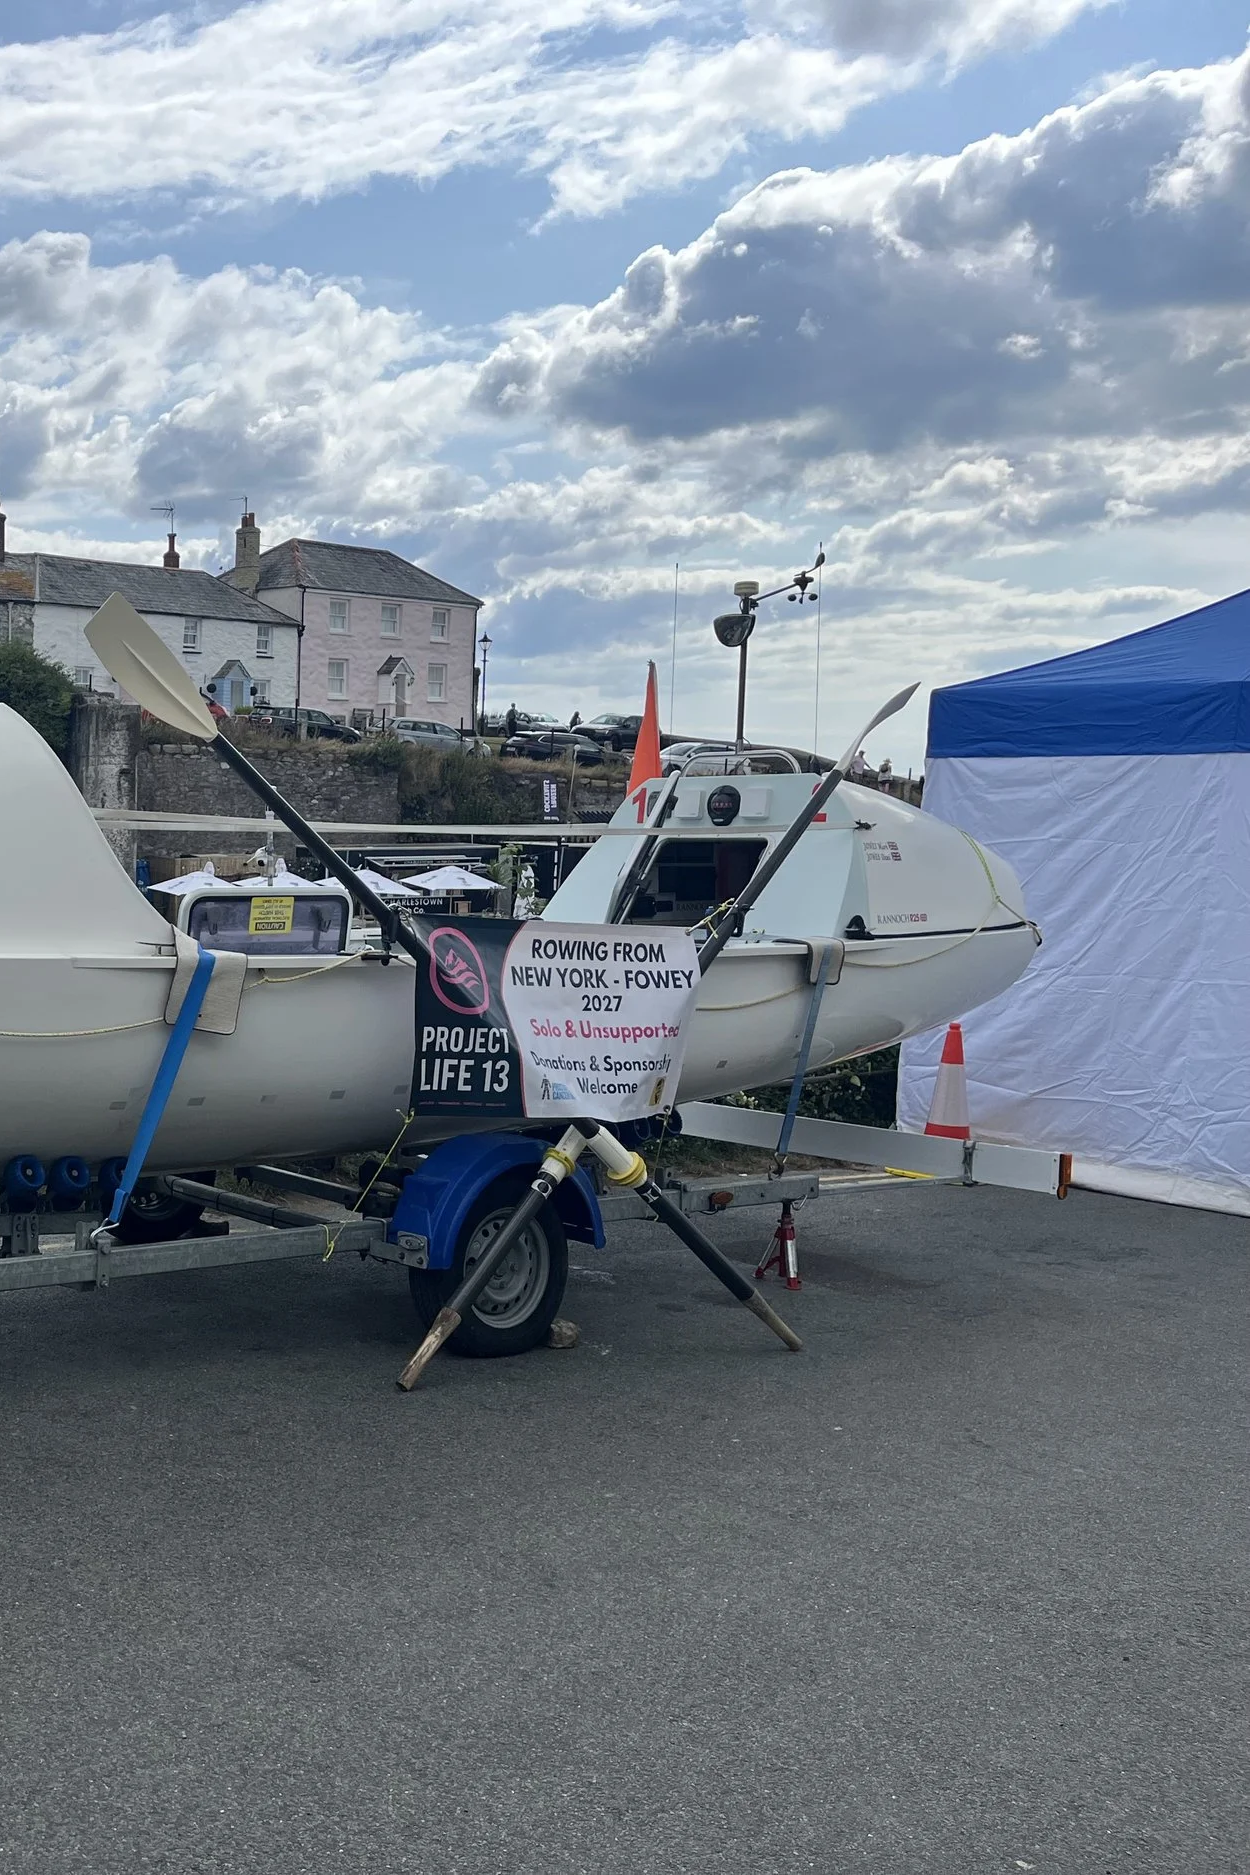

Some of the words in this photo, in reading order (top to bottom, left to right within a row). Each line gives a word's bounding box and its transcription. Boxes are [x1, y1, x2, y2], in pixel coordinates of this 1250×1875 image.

[384, 898, 443, 906] CHARLESTOWN
[256, 922, 285, 931] CAUTION
[877, 913, 909, 924] RANNOCH
[532, 939, 608, 961] ROWING
[613, 942, 666, 963] FROM
[511, 966, 551, 987] NEW
[556, 967, 609, 988] YORK
[624, 970, 693, 989] FOWEY
[581, 995, 622, 1012] 2027
[530, 1019, 561, 1038] Solo
[565, 1020, 578, 1038] &
[421, 1026, 510, 1054] PROJECT
[530, 1051, 586, 1072] Donations
[590, 1055, 601, 1072] &
[420, 1058, 475, 1091] LIFE
[482, 1060, 510, 1093] 13
[576, 1077, 638, 1095] Welcome
